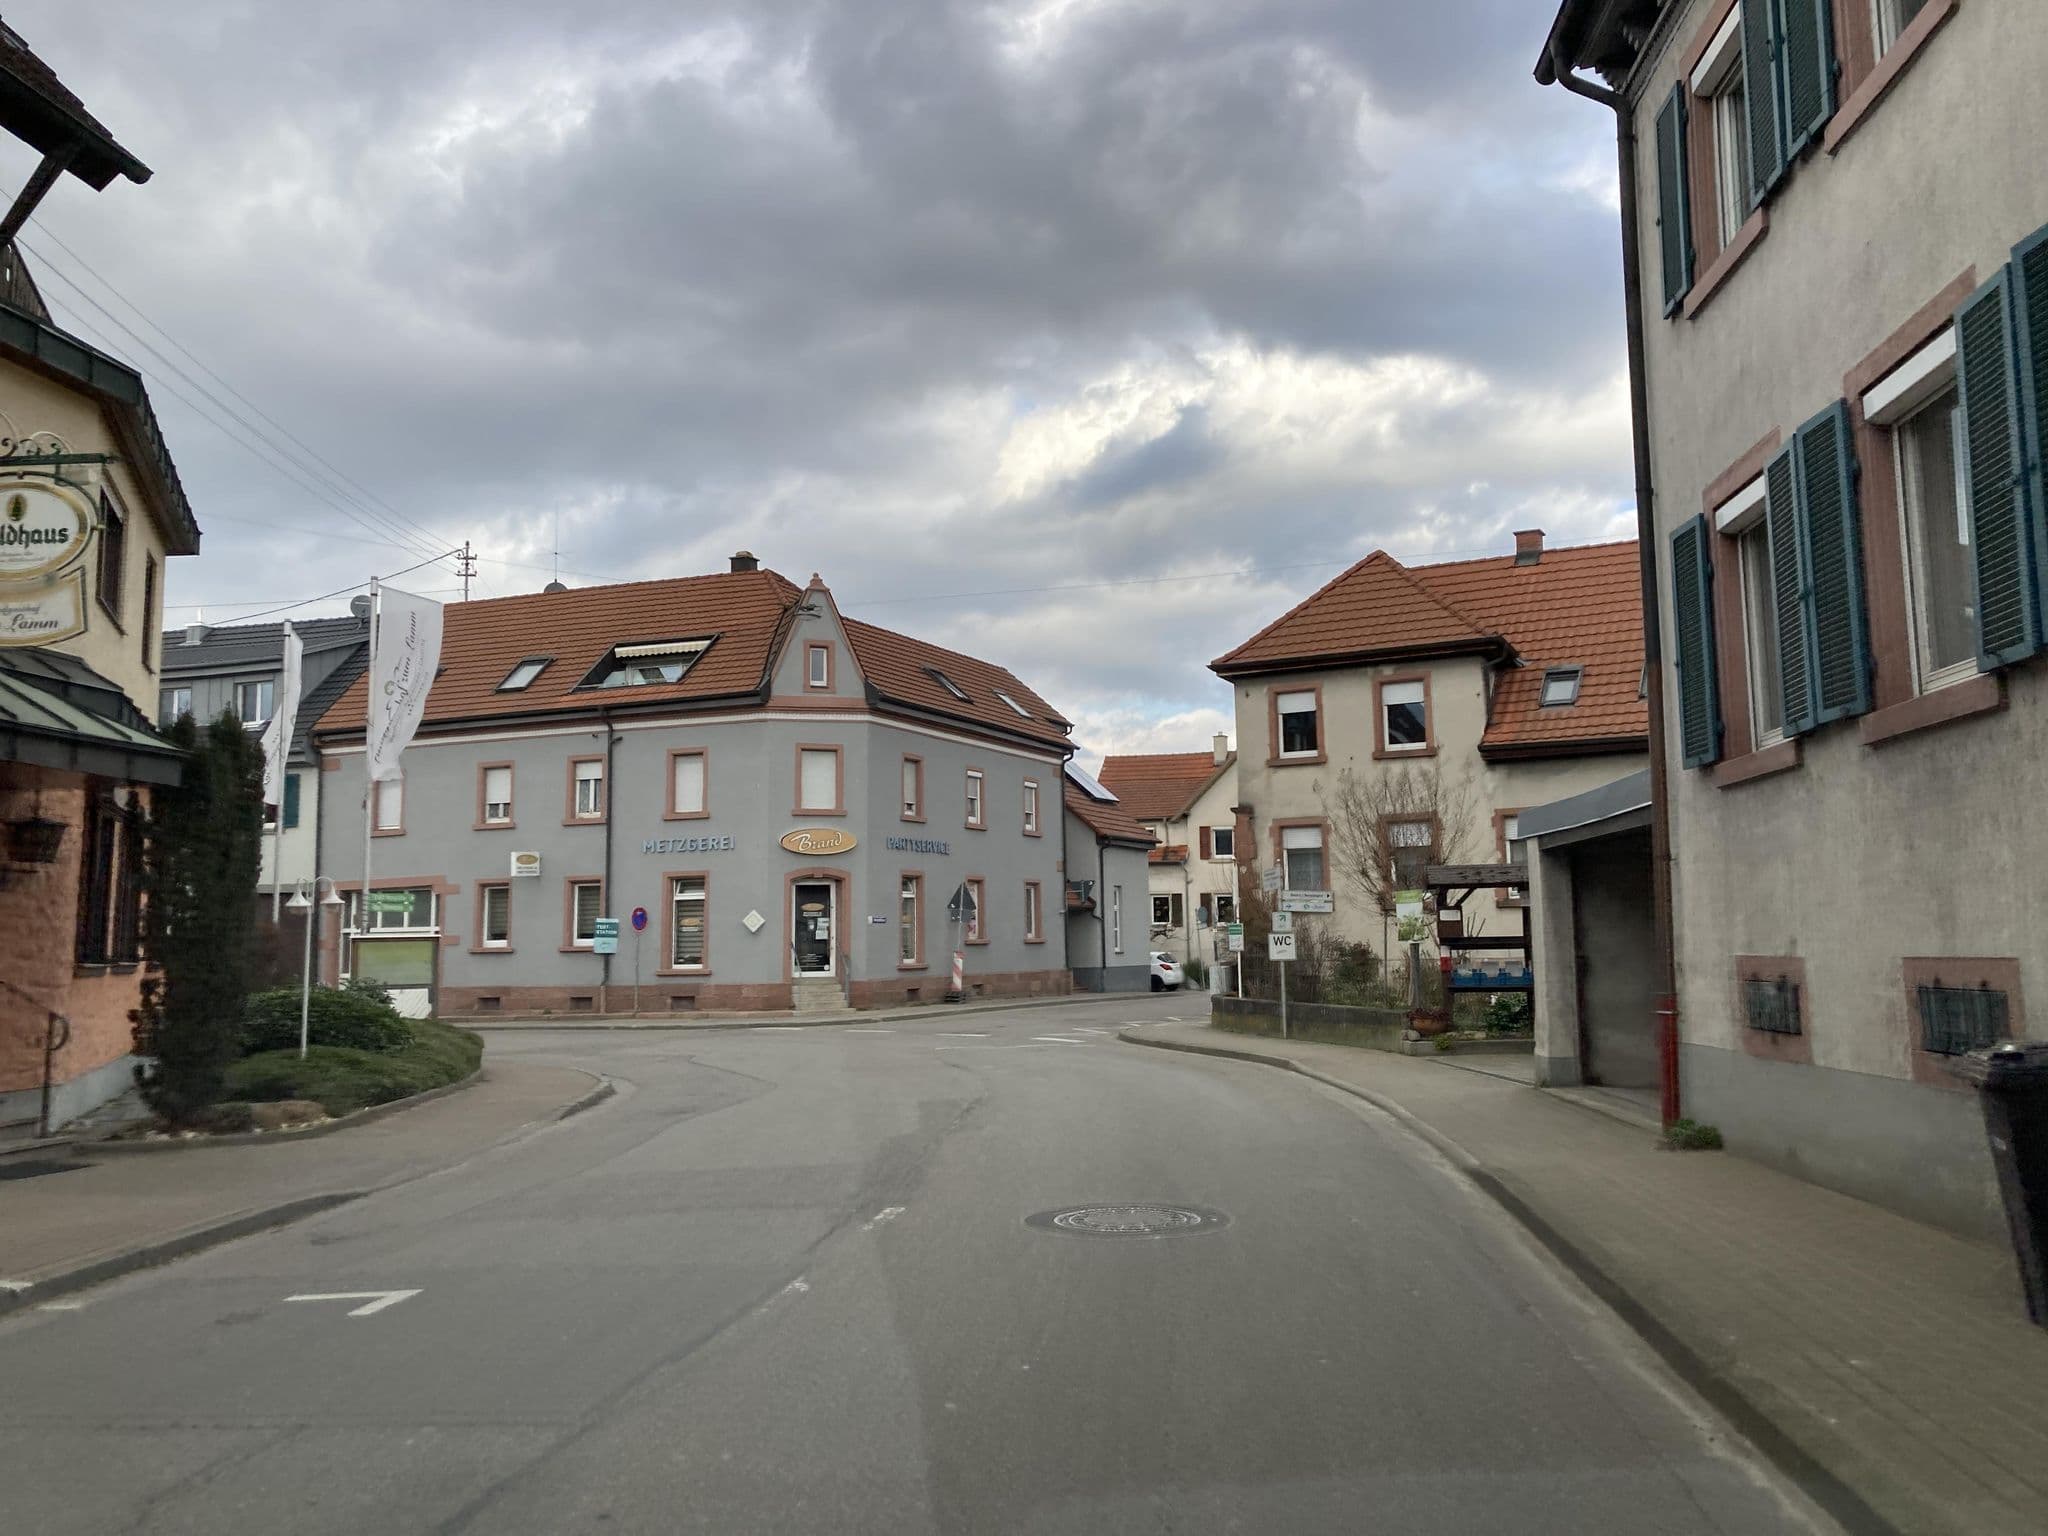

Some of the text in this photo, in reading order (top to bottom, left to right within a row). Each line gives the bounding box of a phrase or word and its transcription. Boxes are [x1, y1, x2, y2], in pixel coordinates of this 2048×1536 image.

[12, 614, 59, 632] Lamm
[642, 835, 734, 854] METZGEREI
[791, 832, 842, 852] Brand
[888, 836, 951, 855] PARTYSERVICE
[1274, 936, 1291, 946] WC
